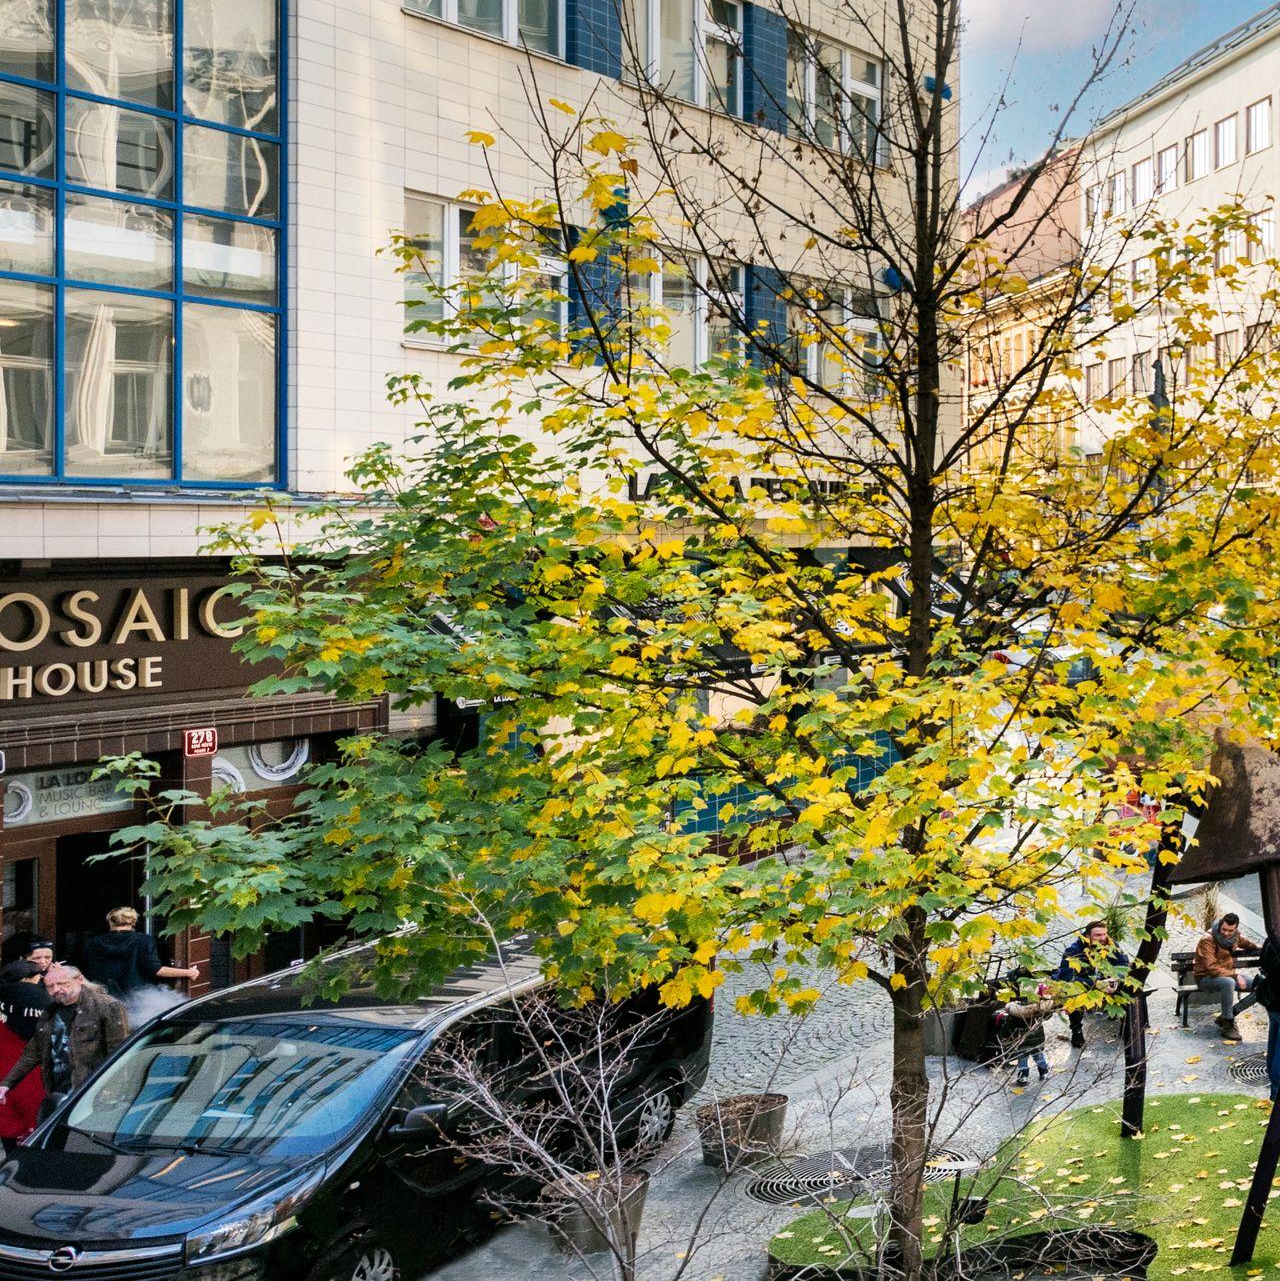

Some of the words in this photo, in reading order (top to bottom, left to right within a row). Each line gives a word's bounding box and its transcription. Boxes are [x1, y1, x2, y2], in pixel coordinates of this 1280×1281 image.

[0, 656, 163, 700] HOUSE
[191, 731, 213, 744] 278
[39, 789, 82, 803] MUSIC
